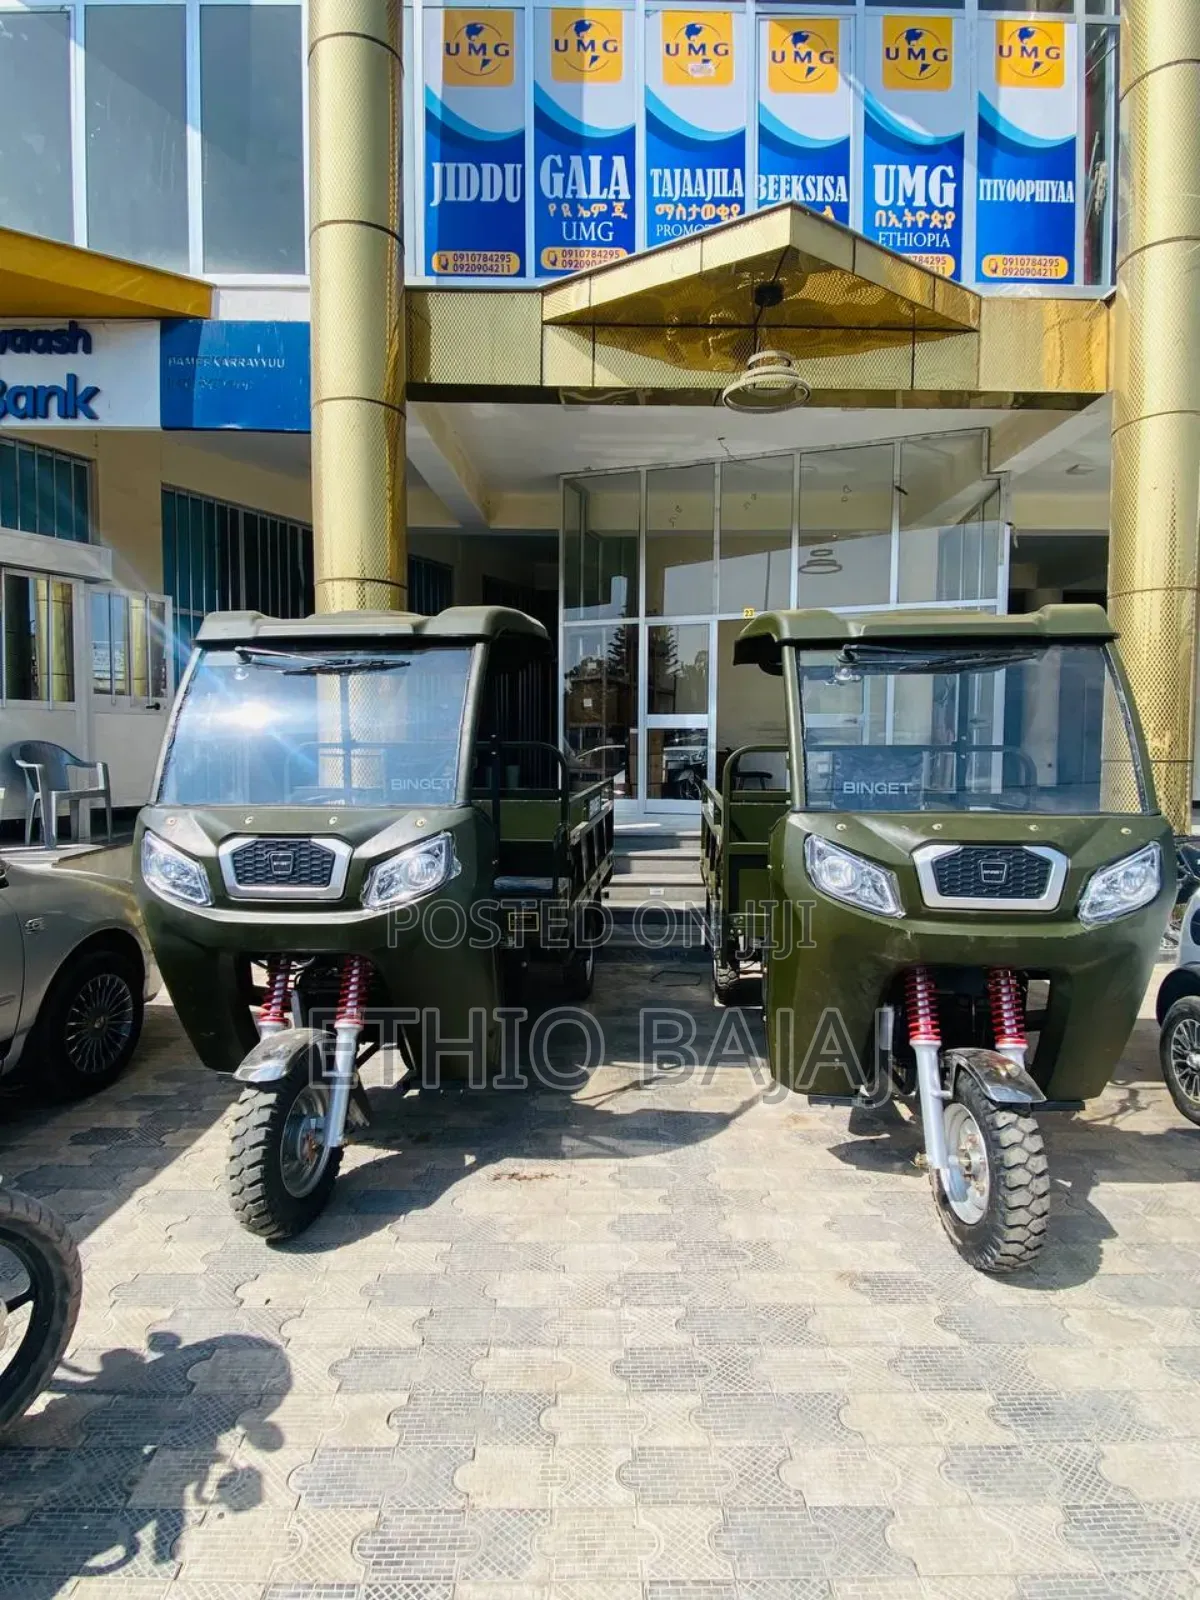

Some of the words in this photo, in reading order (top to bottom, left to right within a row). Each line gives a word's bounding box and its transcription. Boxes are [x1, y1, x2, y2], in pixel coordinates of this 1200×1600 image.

[445, 42, 510, 58] UMG
[554, 39, 619, 53] UMG
[665, 42, 730, 57] UMG
[998, 45, 1061, 60] UMG
[771, 50, 835, 64] UMG
[885, 47, 949, 62] UMG
[430, 162, 523, 207] JIDDU
[539, 154, 631, 200] GALA
[650, 168, 744, 202] TAJAAJILA
[757, 174, 848, 203] BEEKSISA
[873, 164, 956, 208] UMG
[979, 178, 1075, 203] ITIYOOPHIYAA
[562, 221, 614, 242] UMG
[879, 232, 951, 248] ETHIOPIA
[453, 253, 511, 263] 0910784295
[561, 249, 620, 259] 0910784295
[908, 255, 947, 266] 784295
[453, 264, 511, 273] 0920904211
[1001, 257, 1060, 267] 0910784295
[1001, 268, 1060, 277] 0920904211
[0, 320, 92, 355] aash
[0, 373, 101, 420] ank
[391, 778, 455, 791] BINGET
[843, 782, 914, 795] BINGET
